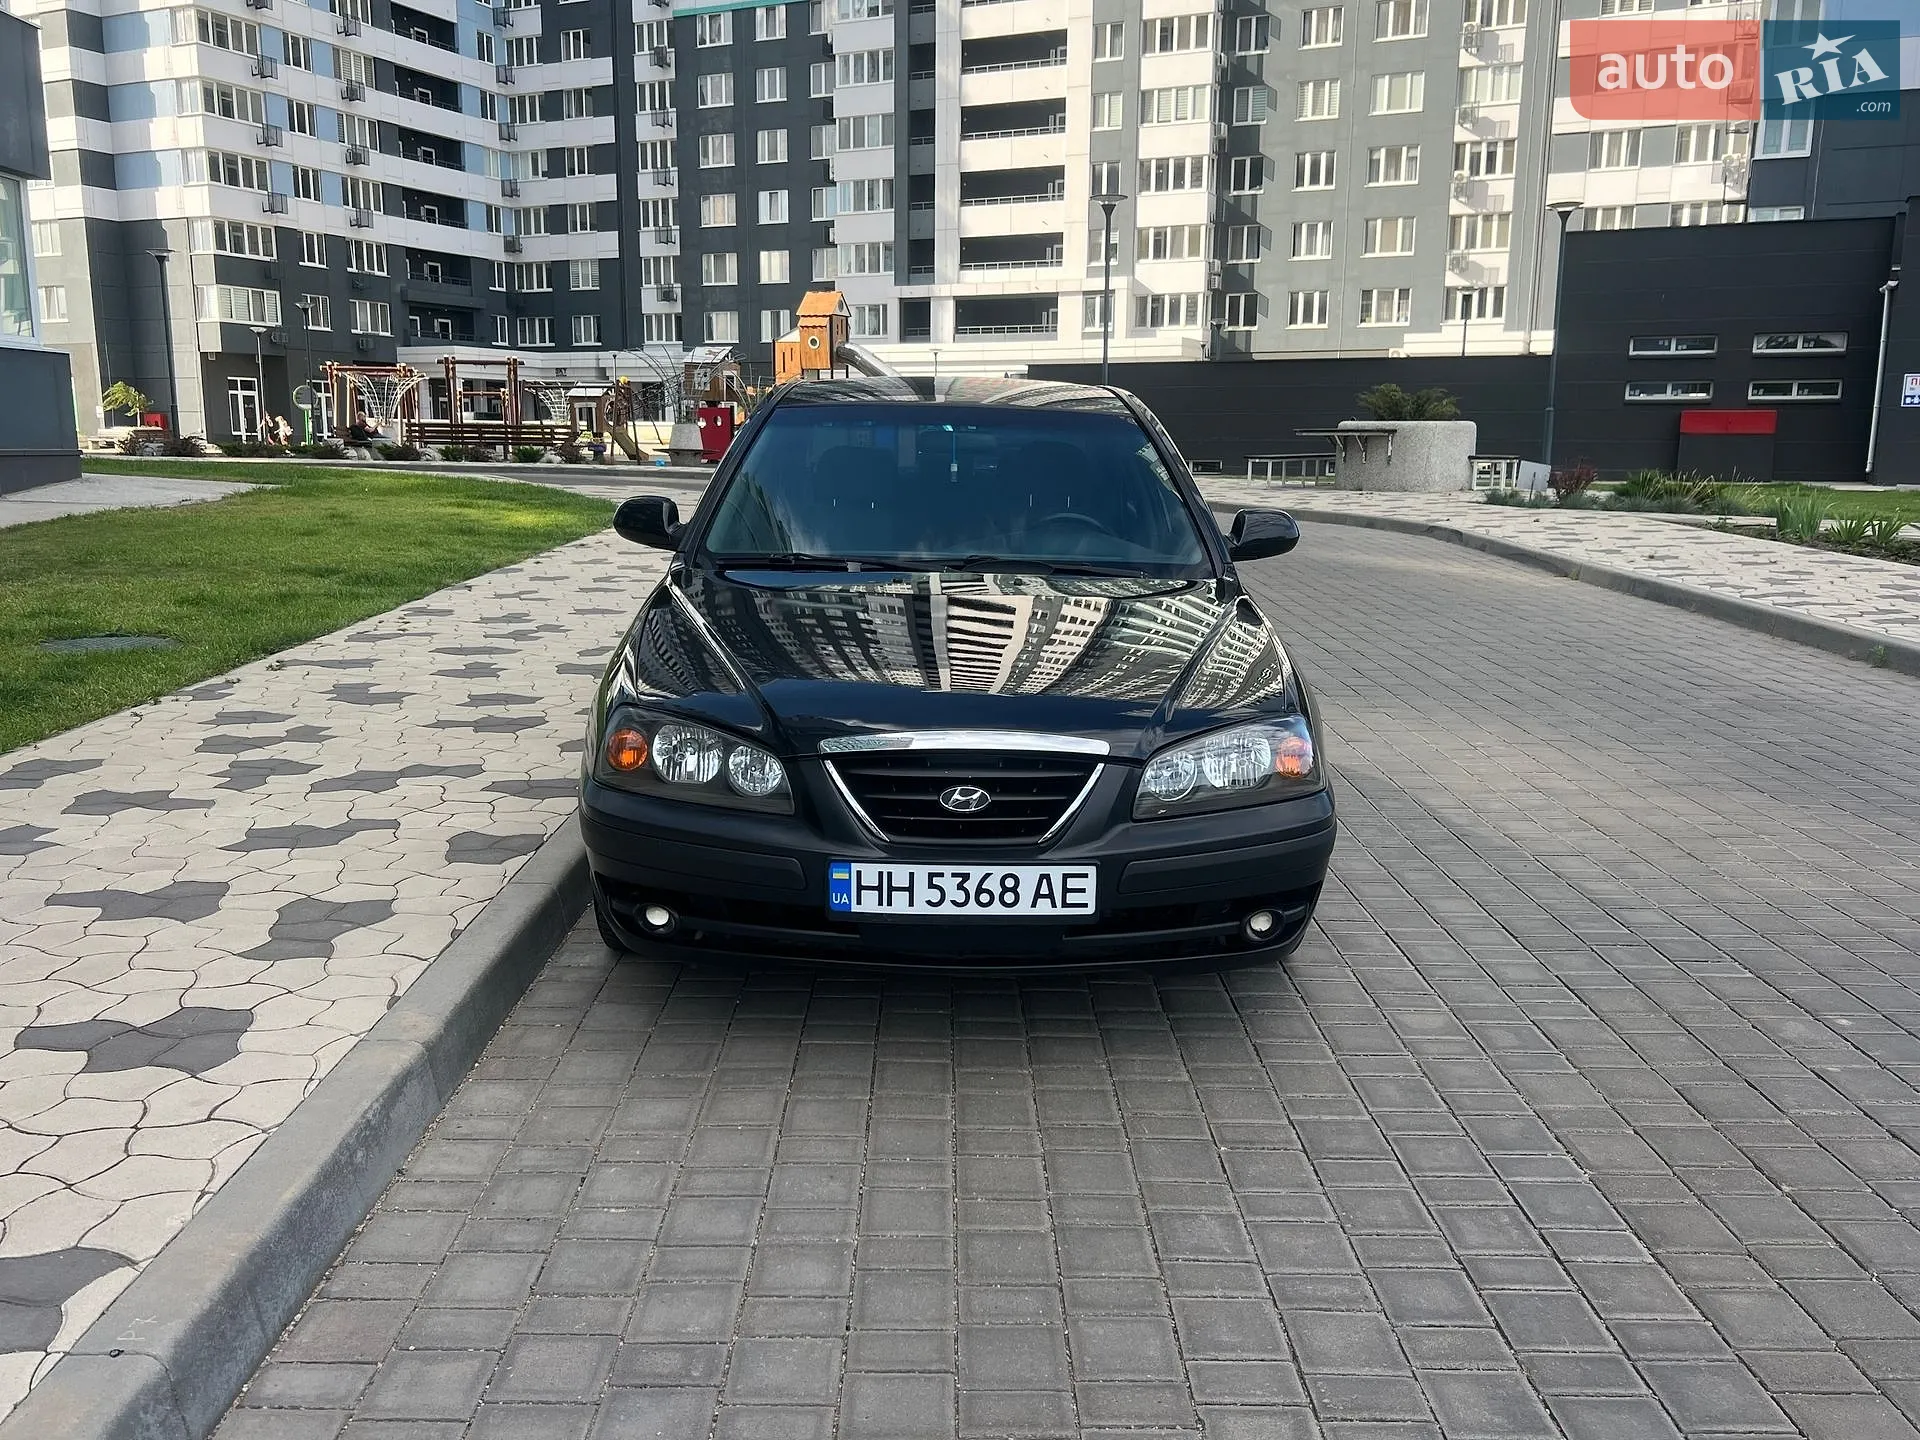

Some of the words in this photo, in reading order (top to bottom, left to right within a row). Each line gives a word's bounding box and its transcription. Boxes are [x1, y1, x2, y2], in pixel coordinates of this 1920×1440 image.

[832, 892, 849, 905] UA
[856, 870, 915, 907] HH
[925, 871, 1020, 908] 5368
[1030, 873, 1089, 908] AE
